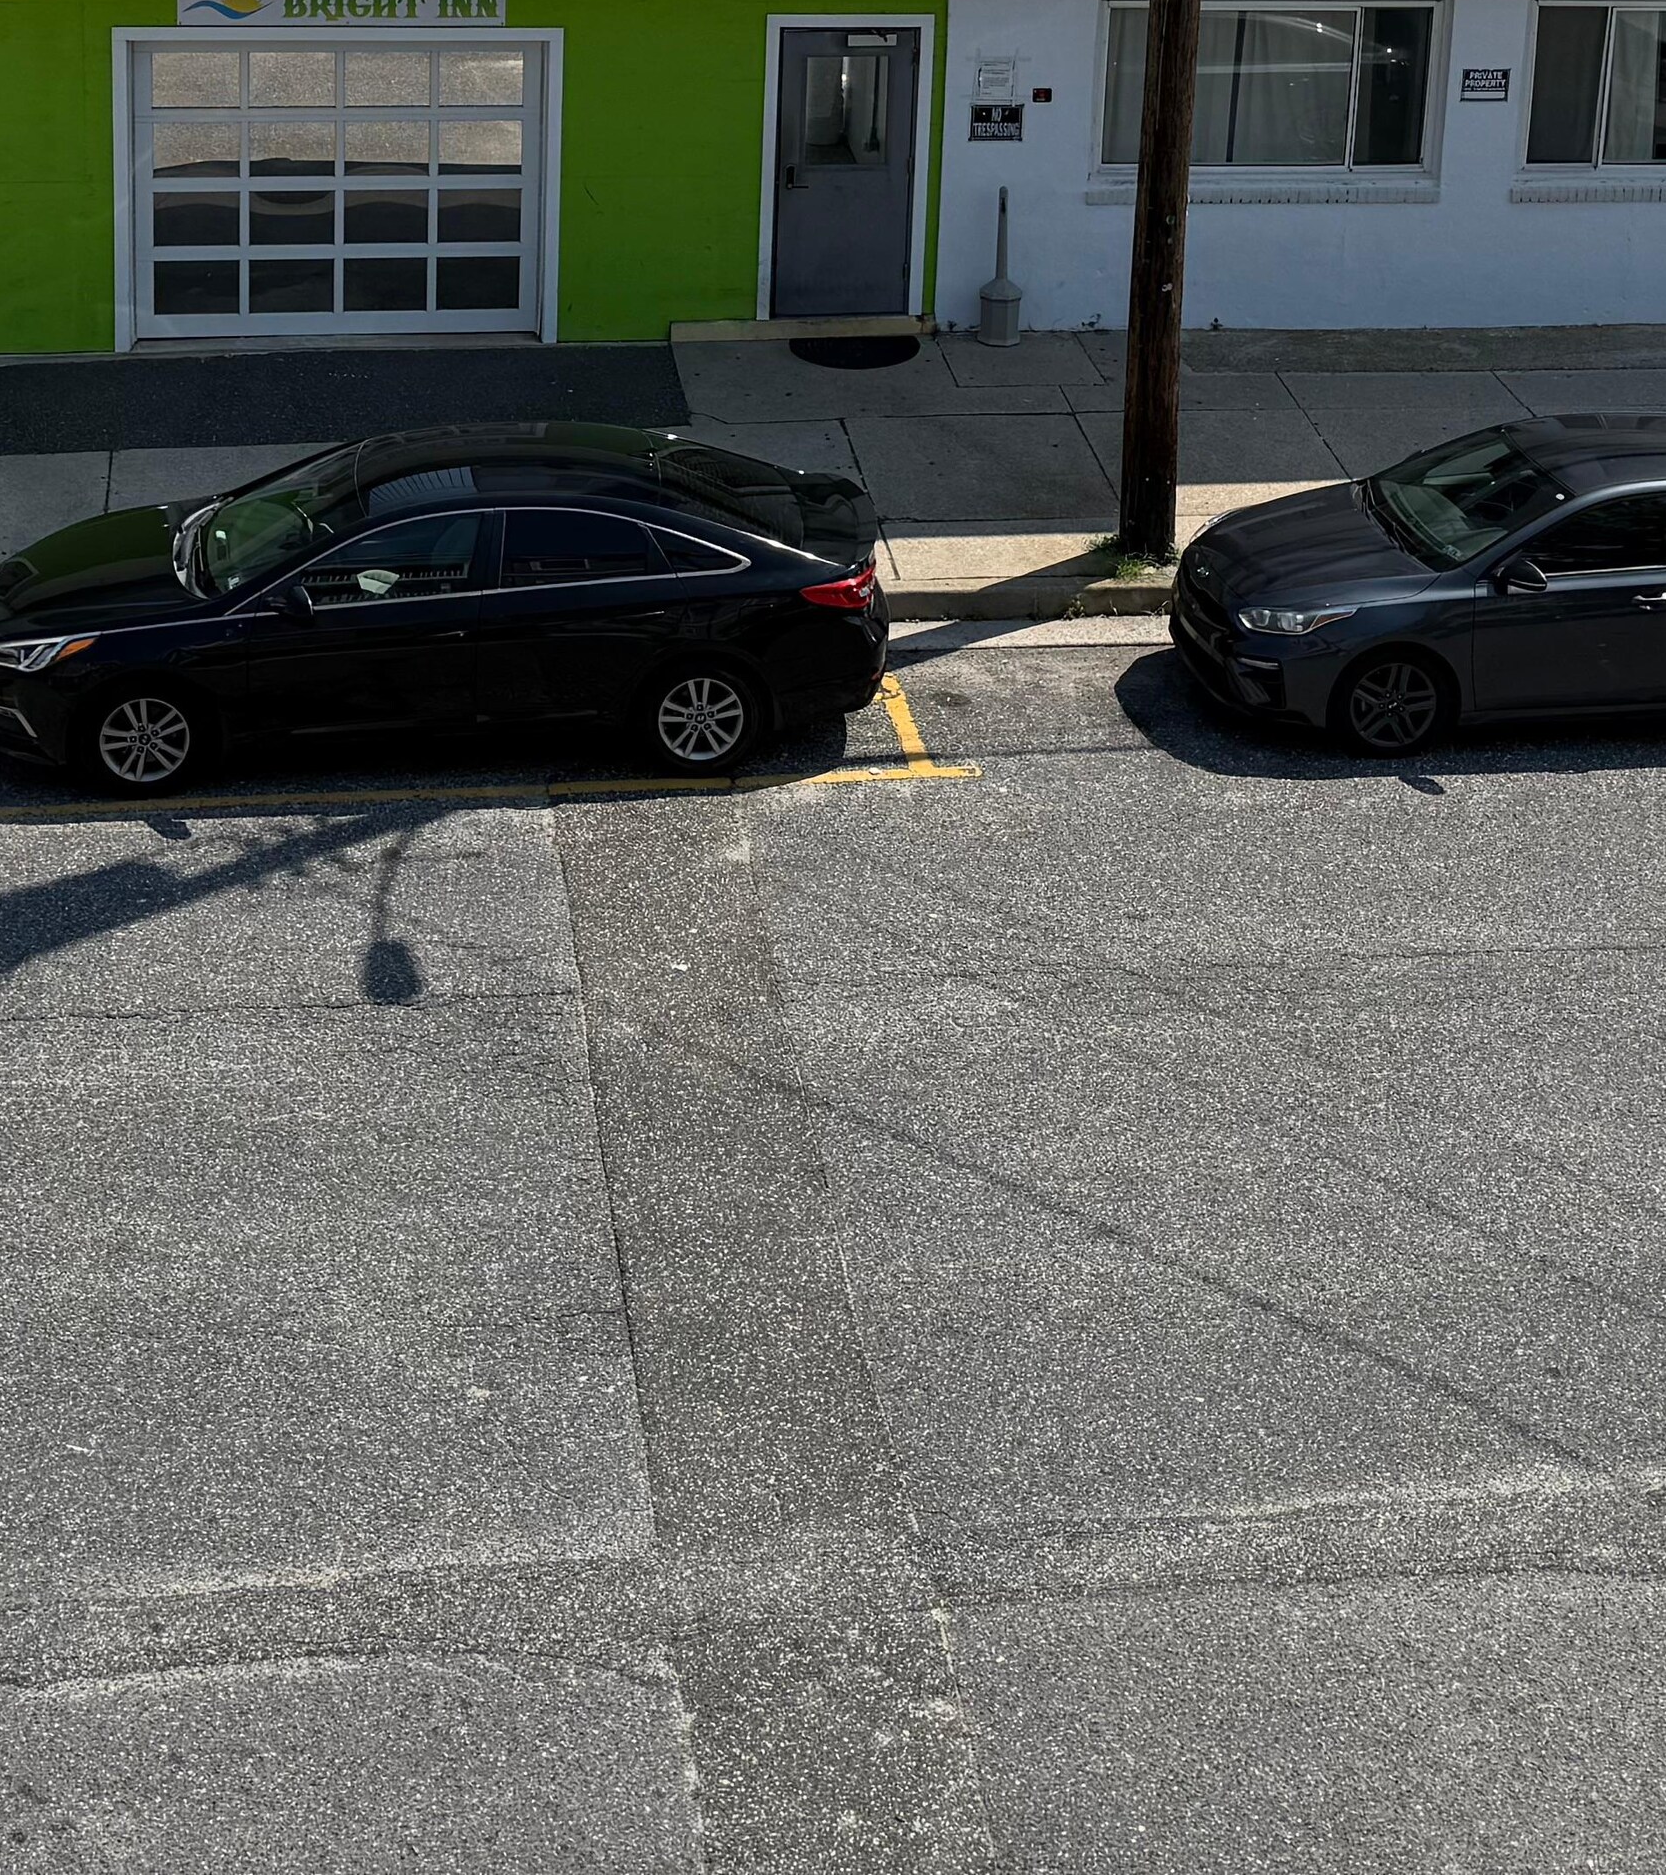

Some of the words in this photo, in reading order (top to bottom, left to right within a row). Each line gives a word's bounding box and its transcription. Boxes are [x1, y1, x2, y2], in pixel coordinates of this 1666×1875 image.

[1469, 71, 1503, 79] PRIVATE
[1464, 79, 1506, 87] PROPERTY
[992, 107, 1002, 122] NO
[973, 122, 1020, 137] TRESPASSING
